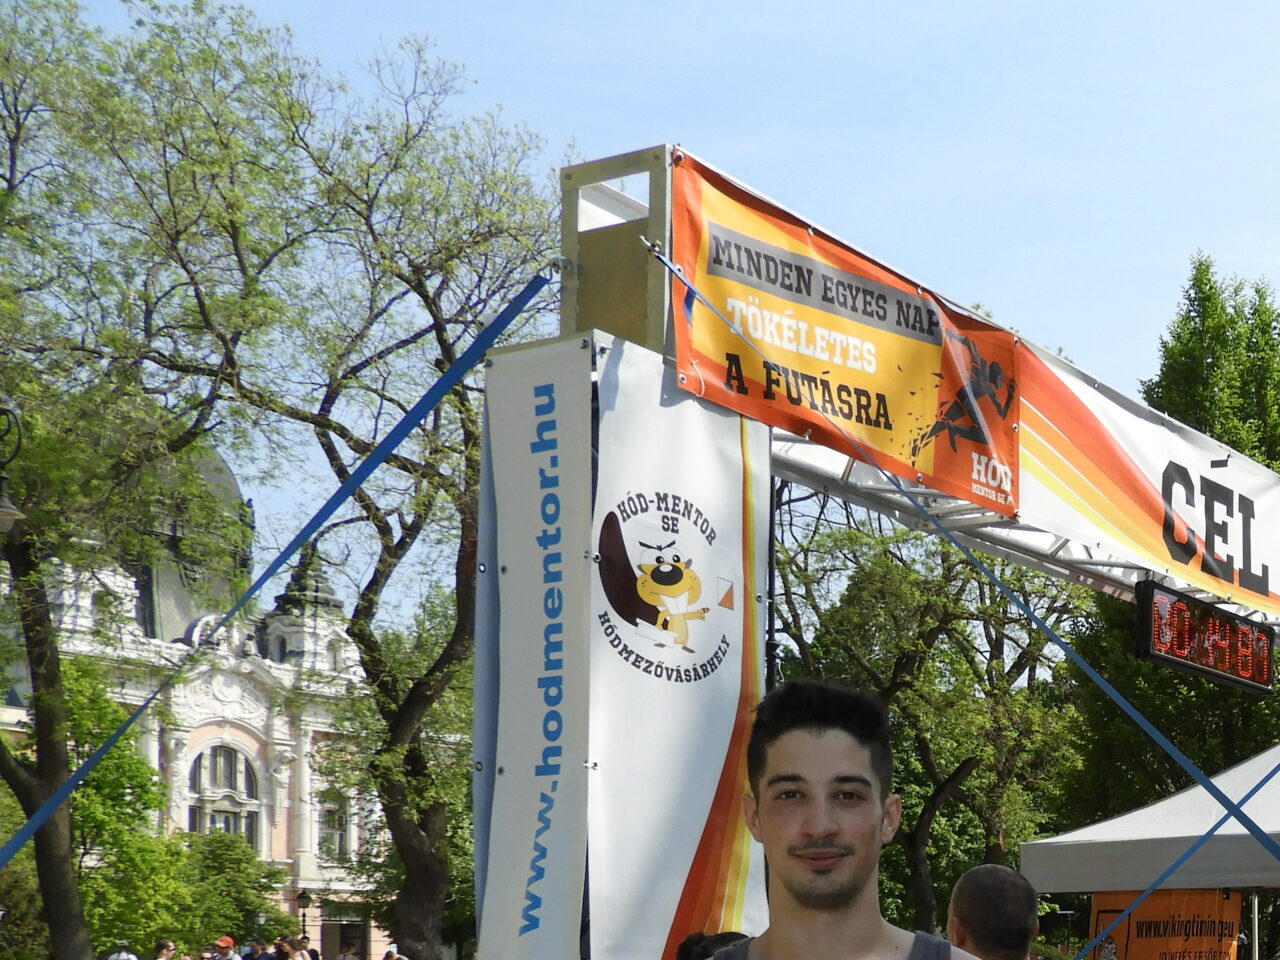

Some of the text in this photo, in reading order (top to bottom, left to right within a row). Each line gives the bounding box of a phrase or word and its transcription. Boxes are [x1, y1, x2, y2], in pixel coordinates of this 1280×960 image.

[712, 235, 940, 336] MINDEN EGYES NAP
[726, 295, 877, 374] TÖKÉLETES
[724, 352, 893, 430] A FUTÁSRA
[616, 491, 718, 546] HÓD-MENTOR
[662, 515, 679, 534] SE
[1161, 459, 1270, 597] CÉL
[518, 382, 563, 937] www.hodmentor.hu
[598, 611, 731, 683] HÓDMEZŐVÁSÁRHELY
